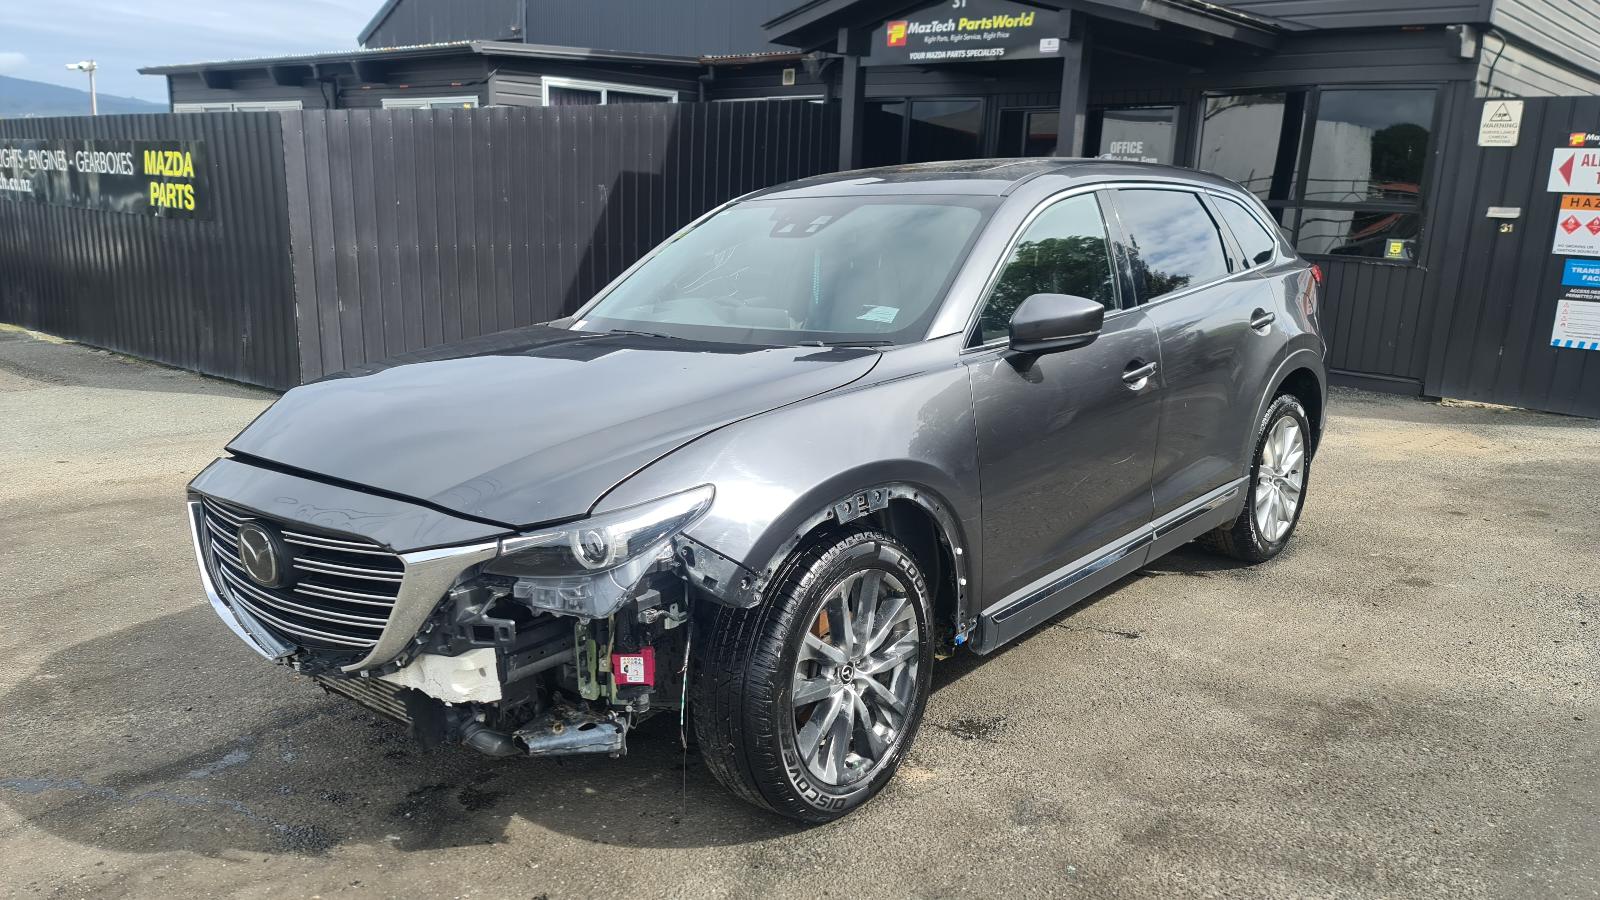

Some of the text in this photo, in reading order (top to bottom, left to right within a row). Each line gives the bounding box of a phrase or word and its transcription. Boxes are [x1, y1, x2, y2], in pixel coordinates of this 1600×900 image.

[907, 11, 1035, 34] MazTech PartsWorld
[909, 48, 1005, 60] YOUR MAZDA PARTS SPECIALISTS
[1110, 141, 1143, 154] OFFICE
[29, 150, 68, 171] ENGINES
[75, 151, 134, 175] GEARBOXES
[144, 150, 195, 178] MAZDA
[1581, 153, 1600, 167] AL
[150, 181, 195, 210] PARTS
